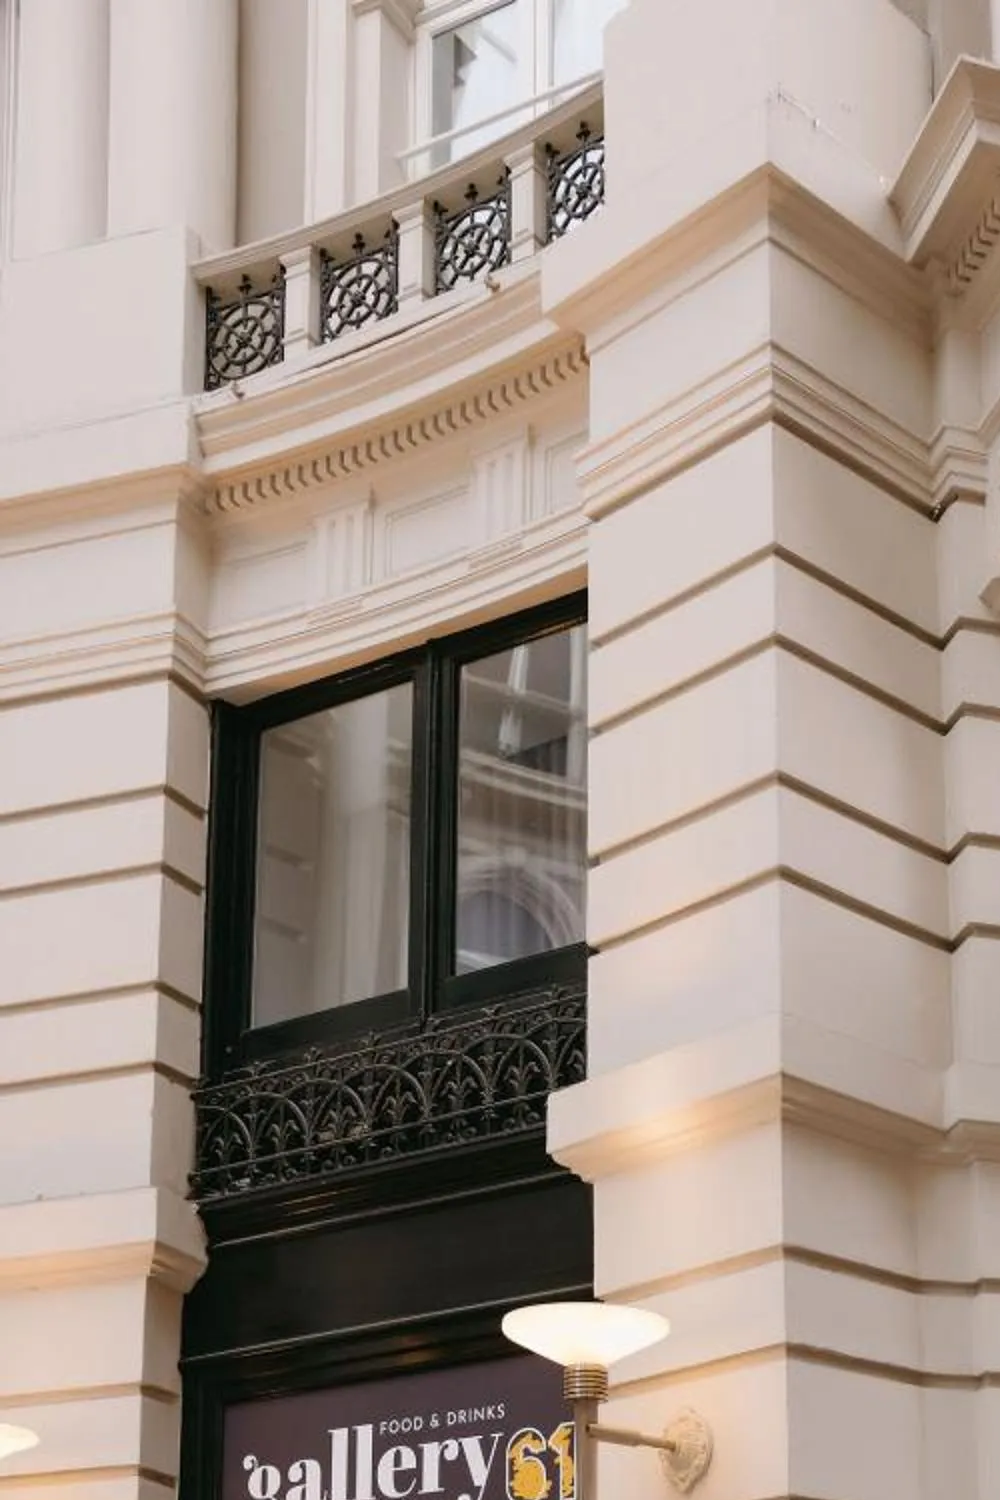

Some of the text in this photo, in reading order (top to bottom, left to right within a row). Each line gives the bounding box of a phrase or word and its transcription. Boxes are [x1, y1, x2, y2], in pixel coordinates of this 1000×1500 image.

[380, 1403, 505, 1435] FOOD & DRINKS
